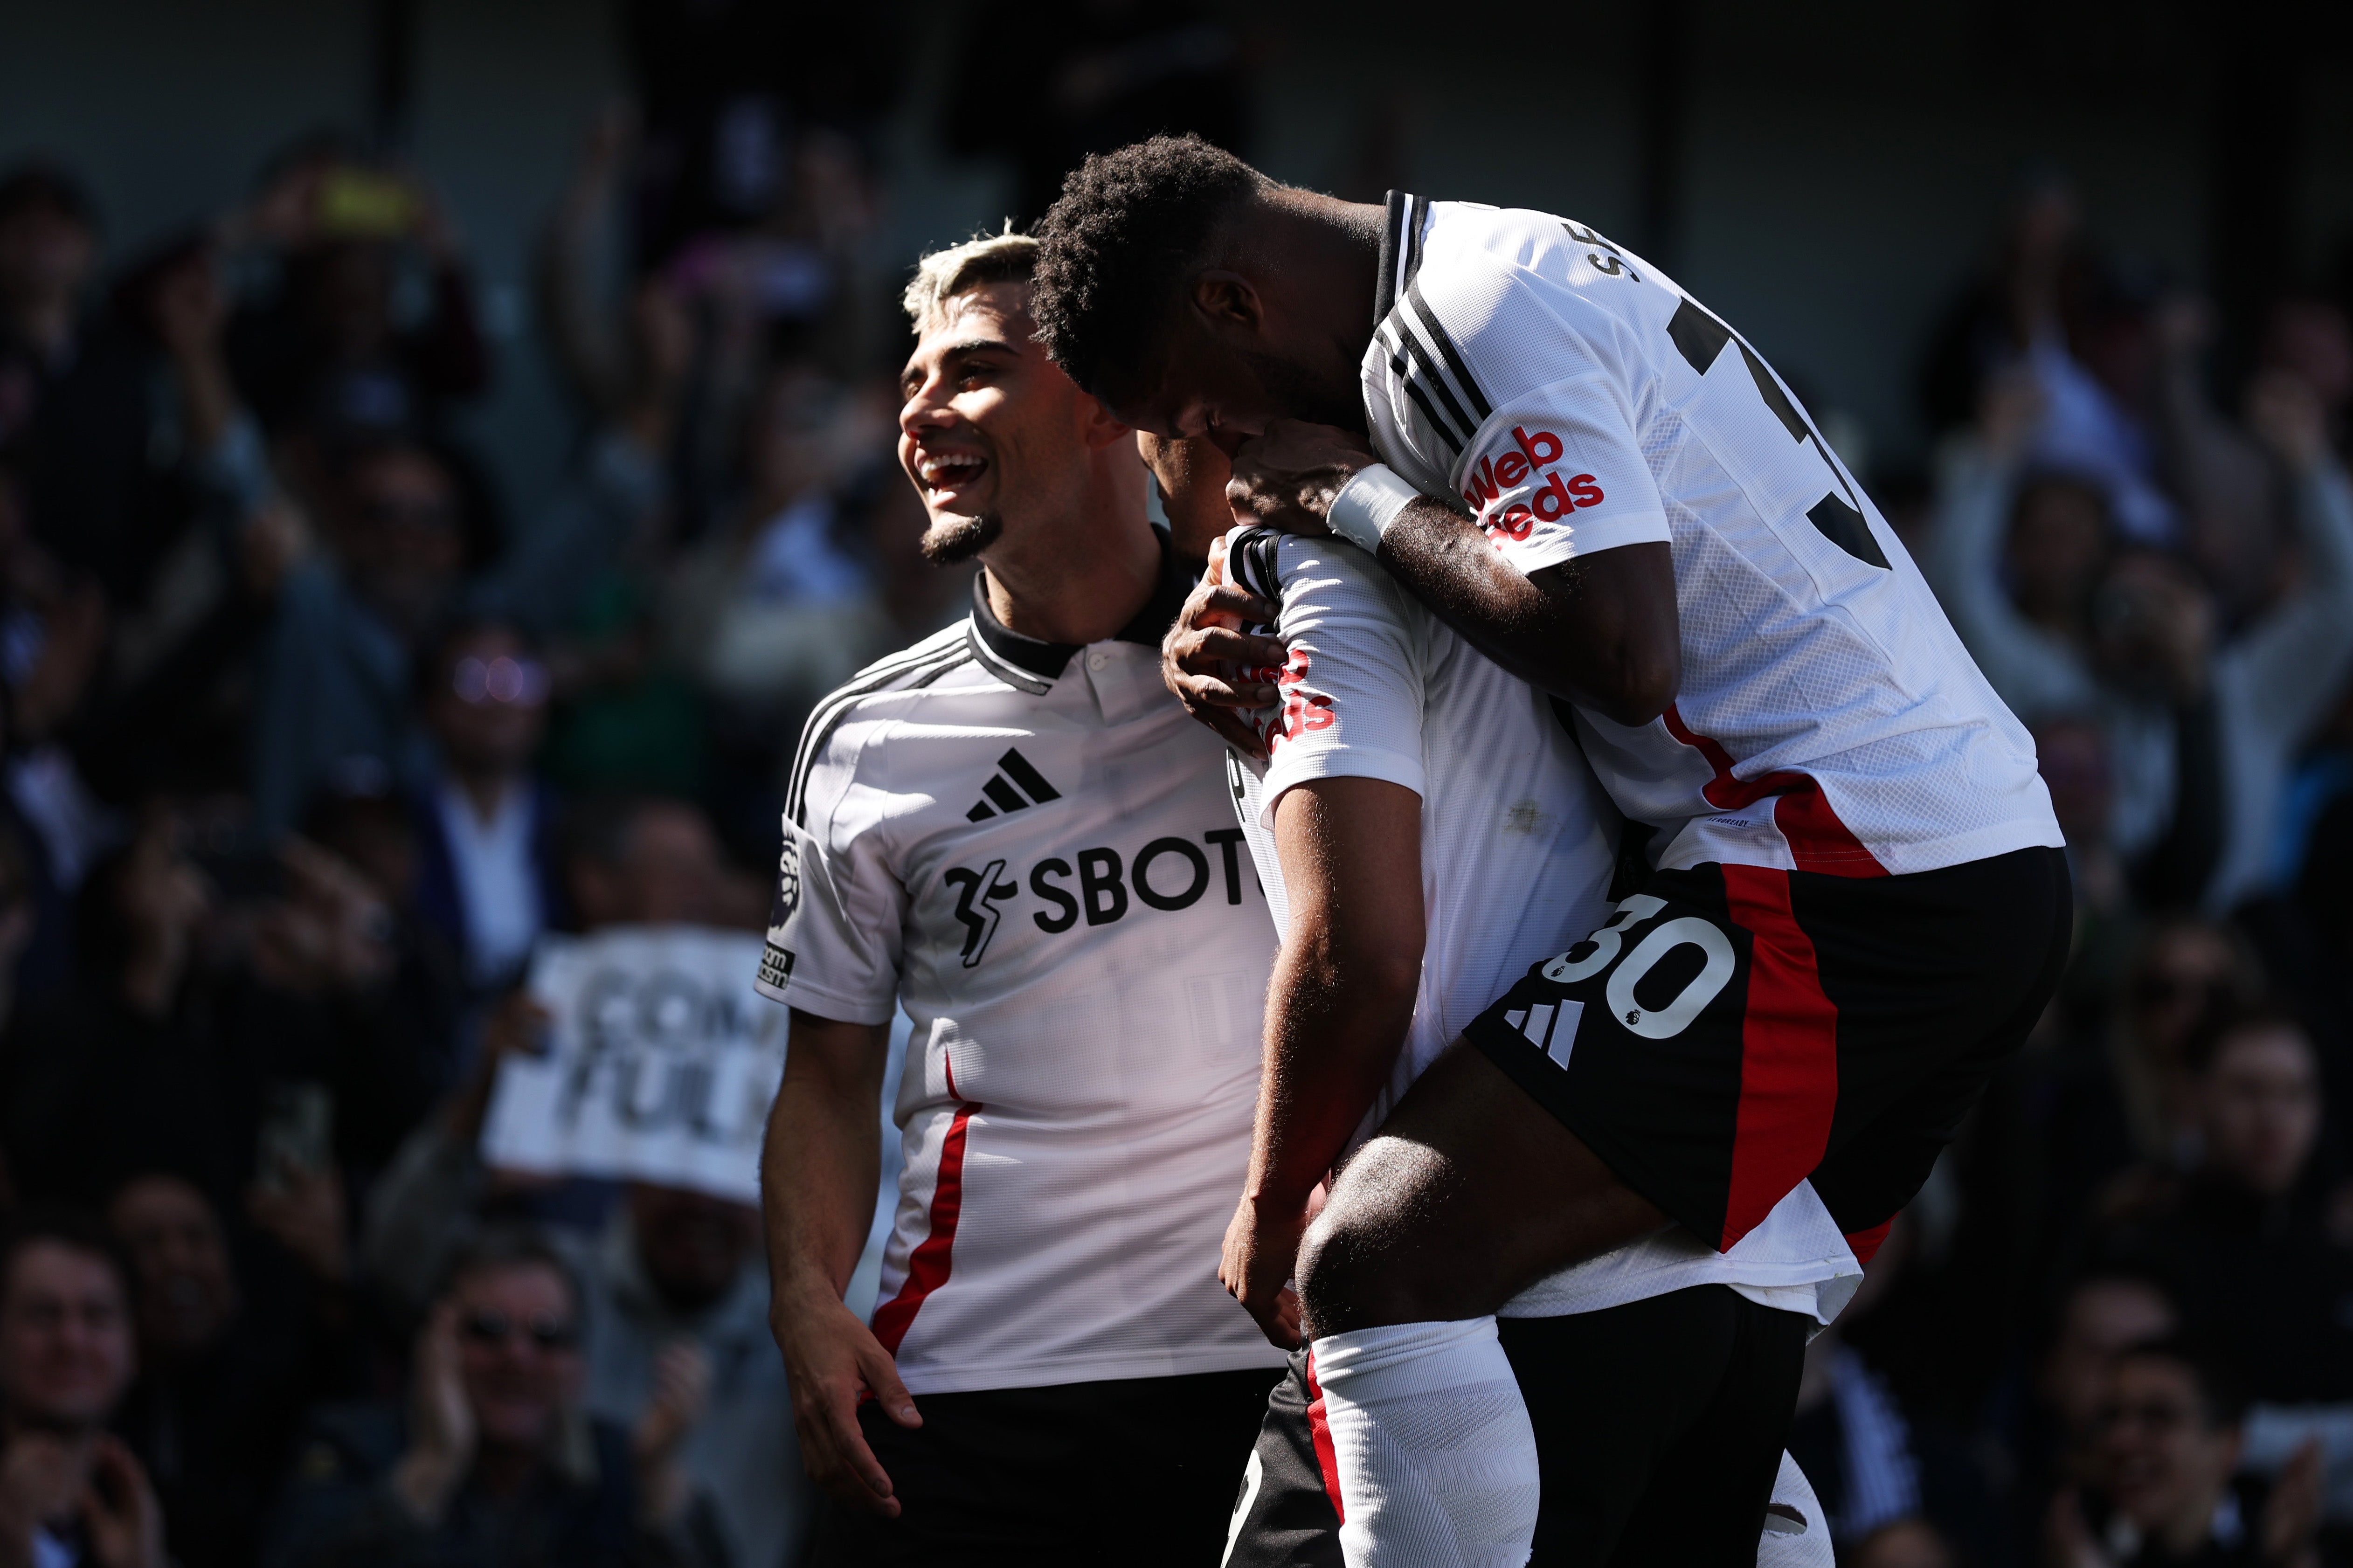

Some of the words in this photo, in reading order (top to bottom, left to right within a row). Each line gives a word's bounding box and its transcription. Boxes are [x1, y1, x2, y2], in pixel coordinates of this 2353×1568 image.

[1706, 817, 1749, 828] AEROREADY
[1030, 828, 1266, 934] SBOT
[1542, 893, 1736, 1040] 30
